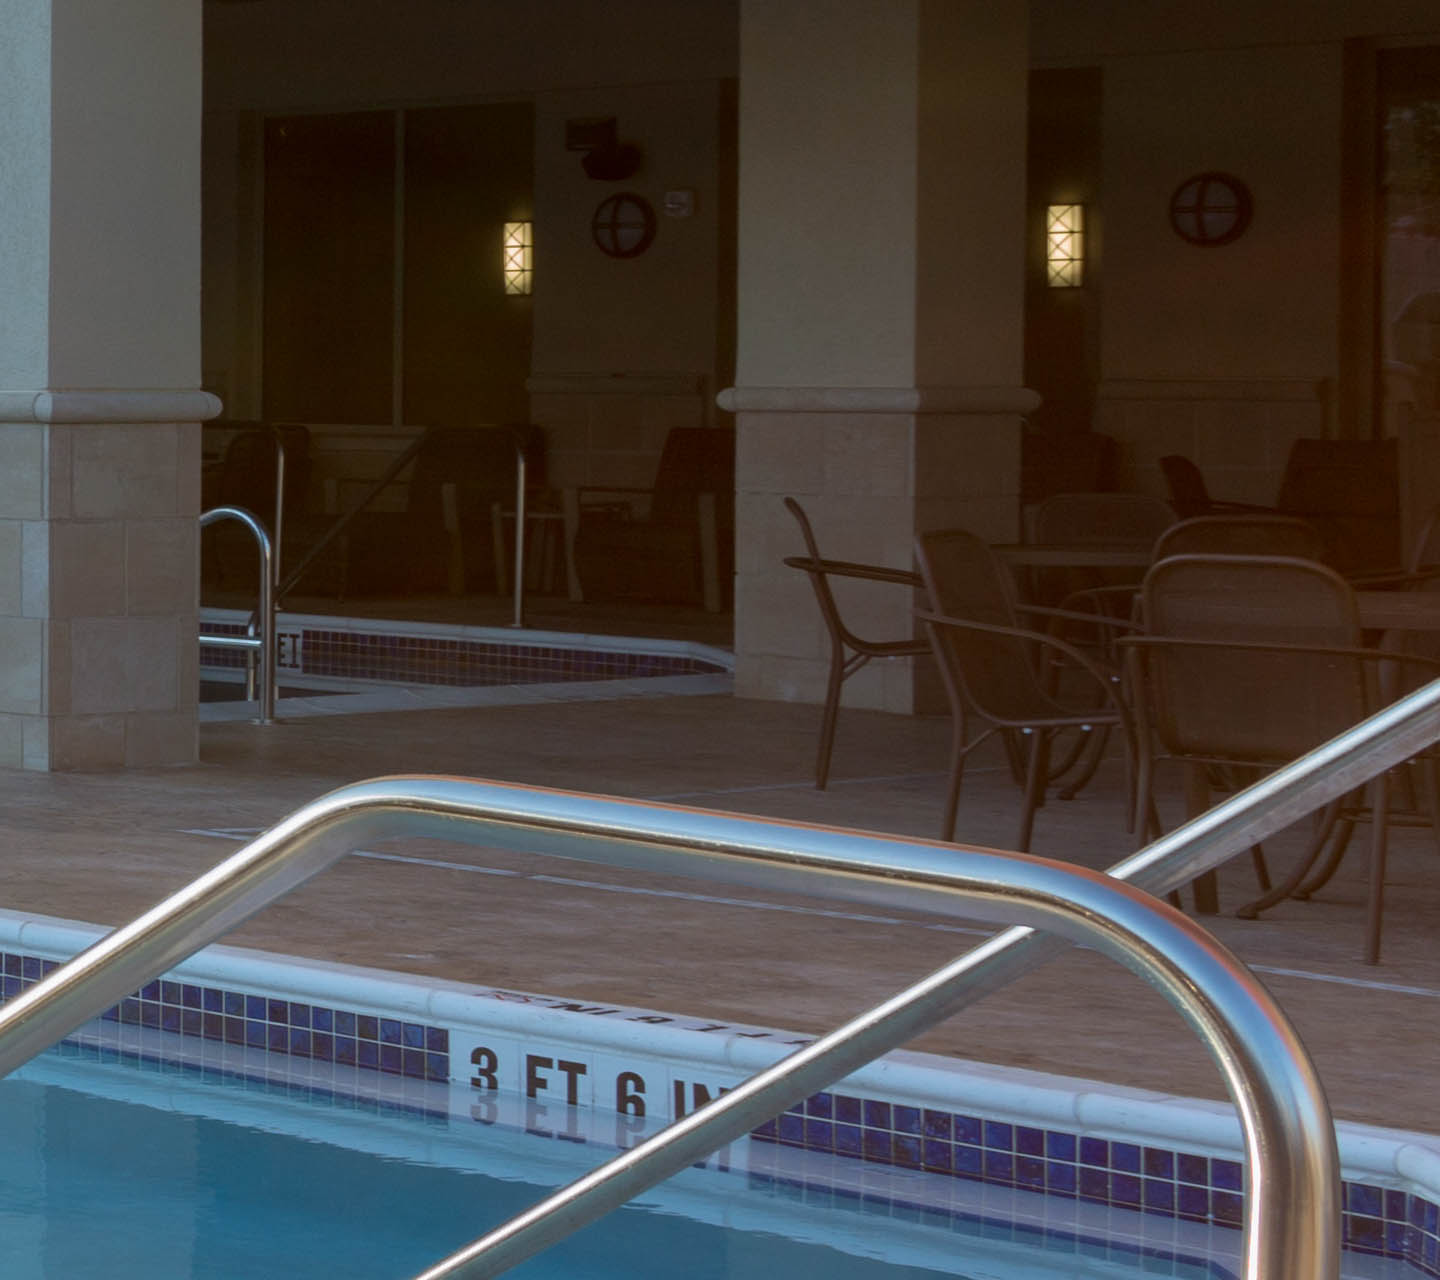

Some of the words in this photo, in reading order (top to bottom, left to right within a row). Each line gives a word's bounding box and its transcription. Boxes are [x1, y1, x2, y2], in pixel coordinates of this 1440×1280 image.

[470, 1047, 498, 1090] 3
[526, 1054, 587, 1106] FT
[616, 1071, 646, 1117] 6
